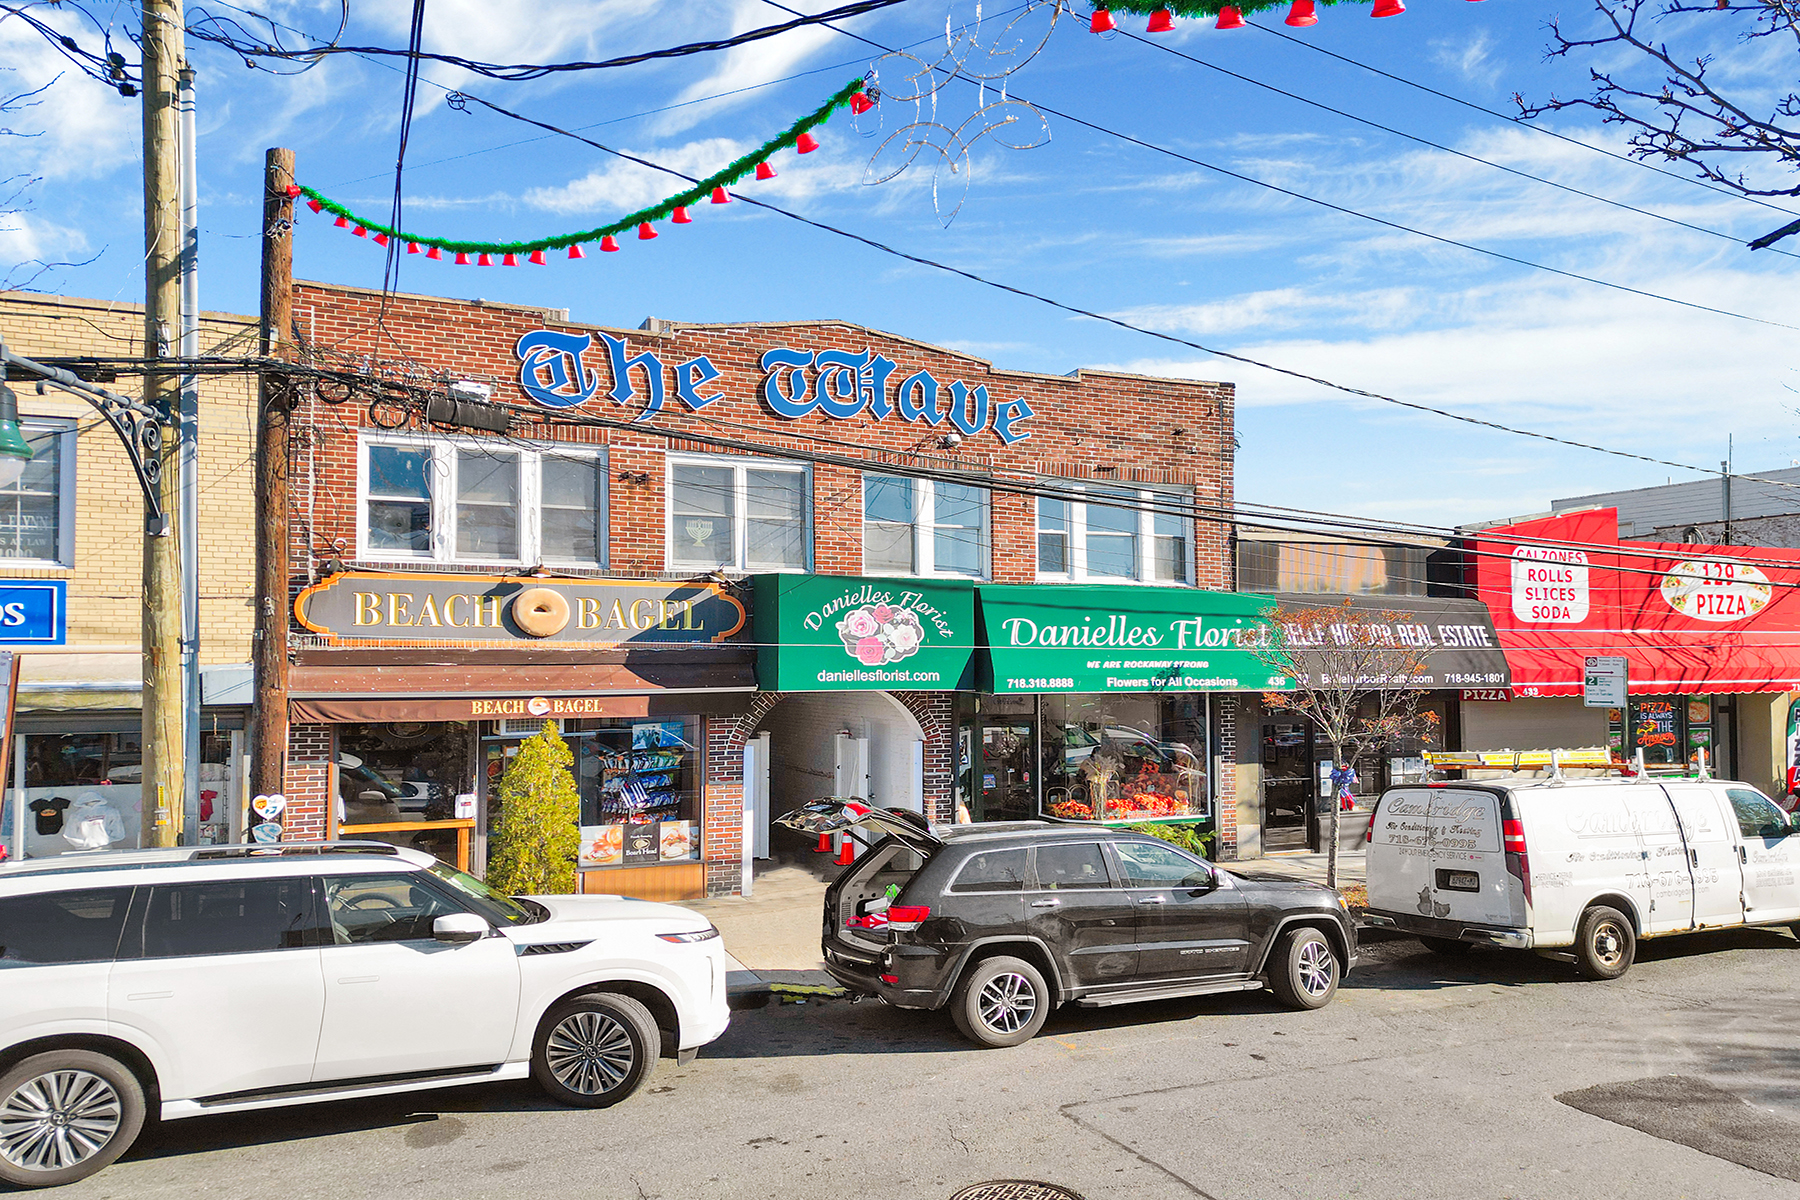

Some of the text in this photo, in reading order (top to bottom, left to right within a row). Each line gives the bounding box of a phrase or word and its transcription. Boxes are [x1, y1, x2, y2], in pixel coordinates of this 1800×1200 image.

[516, 328, 1035, 446] The Wave
[1516, 549, 1583, 563] CALZONES
[1528, 568, 1573, 583] ROLLS
[1702, 562, 1734, 586] 129
[1525, 587, 1576, 602] SLICES
[1697, 593, 1746, 615] PIZZA
[352, 592, 705, 632] BEACH BAGEL
[803, 584, 955, 639] Danielles Florist
[1532, 605, 1571, 619] SODA
[1002, 614, 1272, 650] Danielles Florist
[1398, 624, 1438, 647] REAL
[1438, 624, 1493, 648] ESTATE
[1086, 661, 1210, 669] WE ARE ROCKAWAY STRONG
[816, 669, 940, 682] daniellesflorist.com
[1006, 676, 1286, 689] 718.318.8888 Flowers for All Occasions 436
[1444, 673, 1506, 684] 718-945-1801
[1588, 676, 1595, 685] 2
[1463, 690, 1508, 700] PIZZA
[471, 698, 603, 715] BEACH BAGEL
[1640, 702, 1673, 713] PIZZA
[1648, 712, 1674, 720] ALWAYS
[1657, 720, 1674, 733] THE
[1387, 797, 1486, 823] Cambridge
